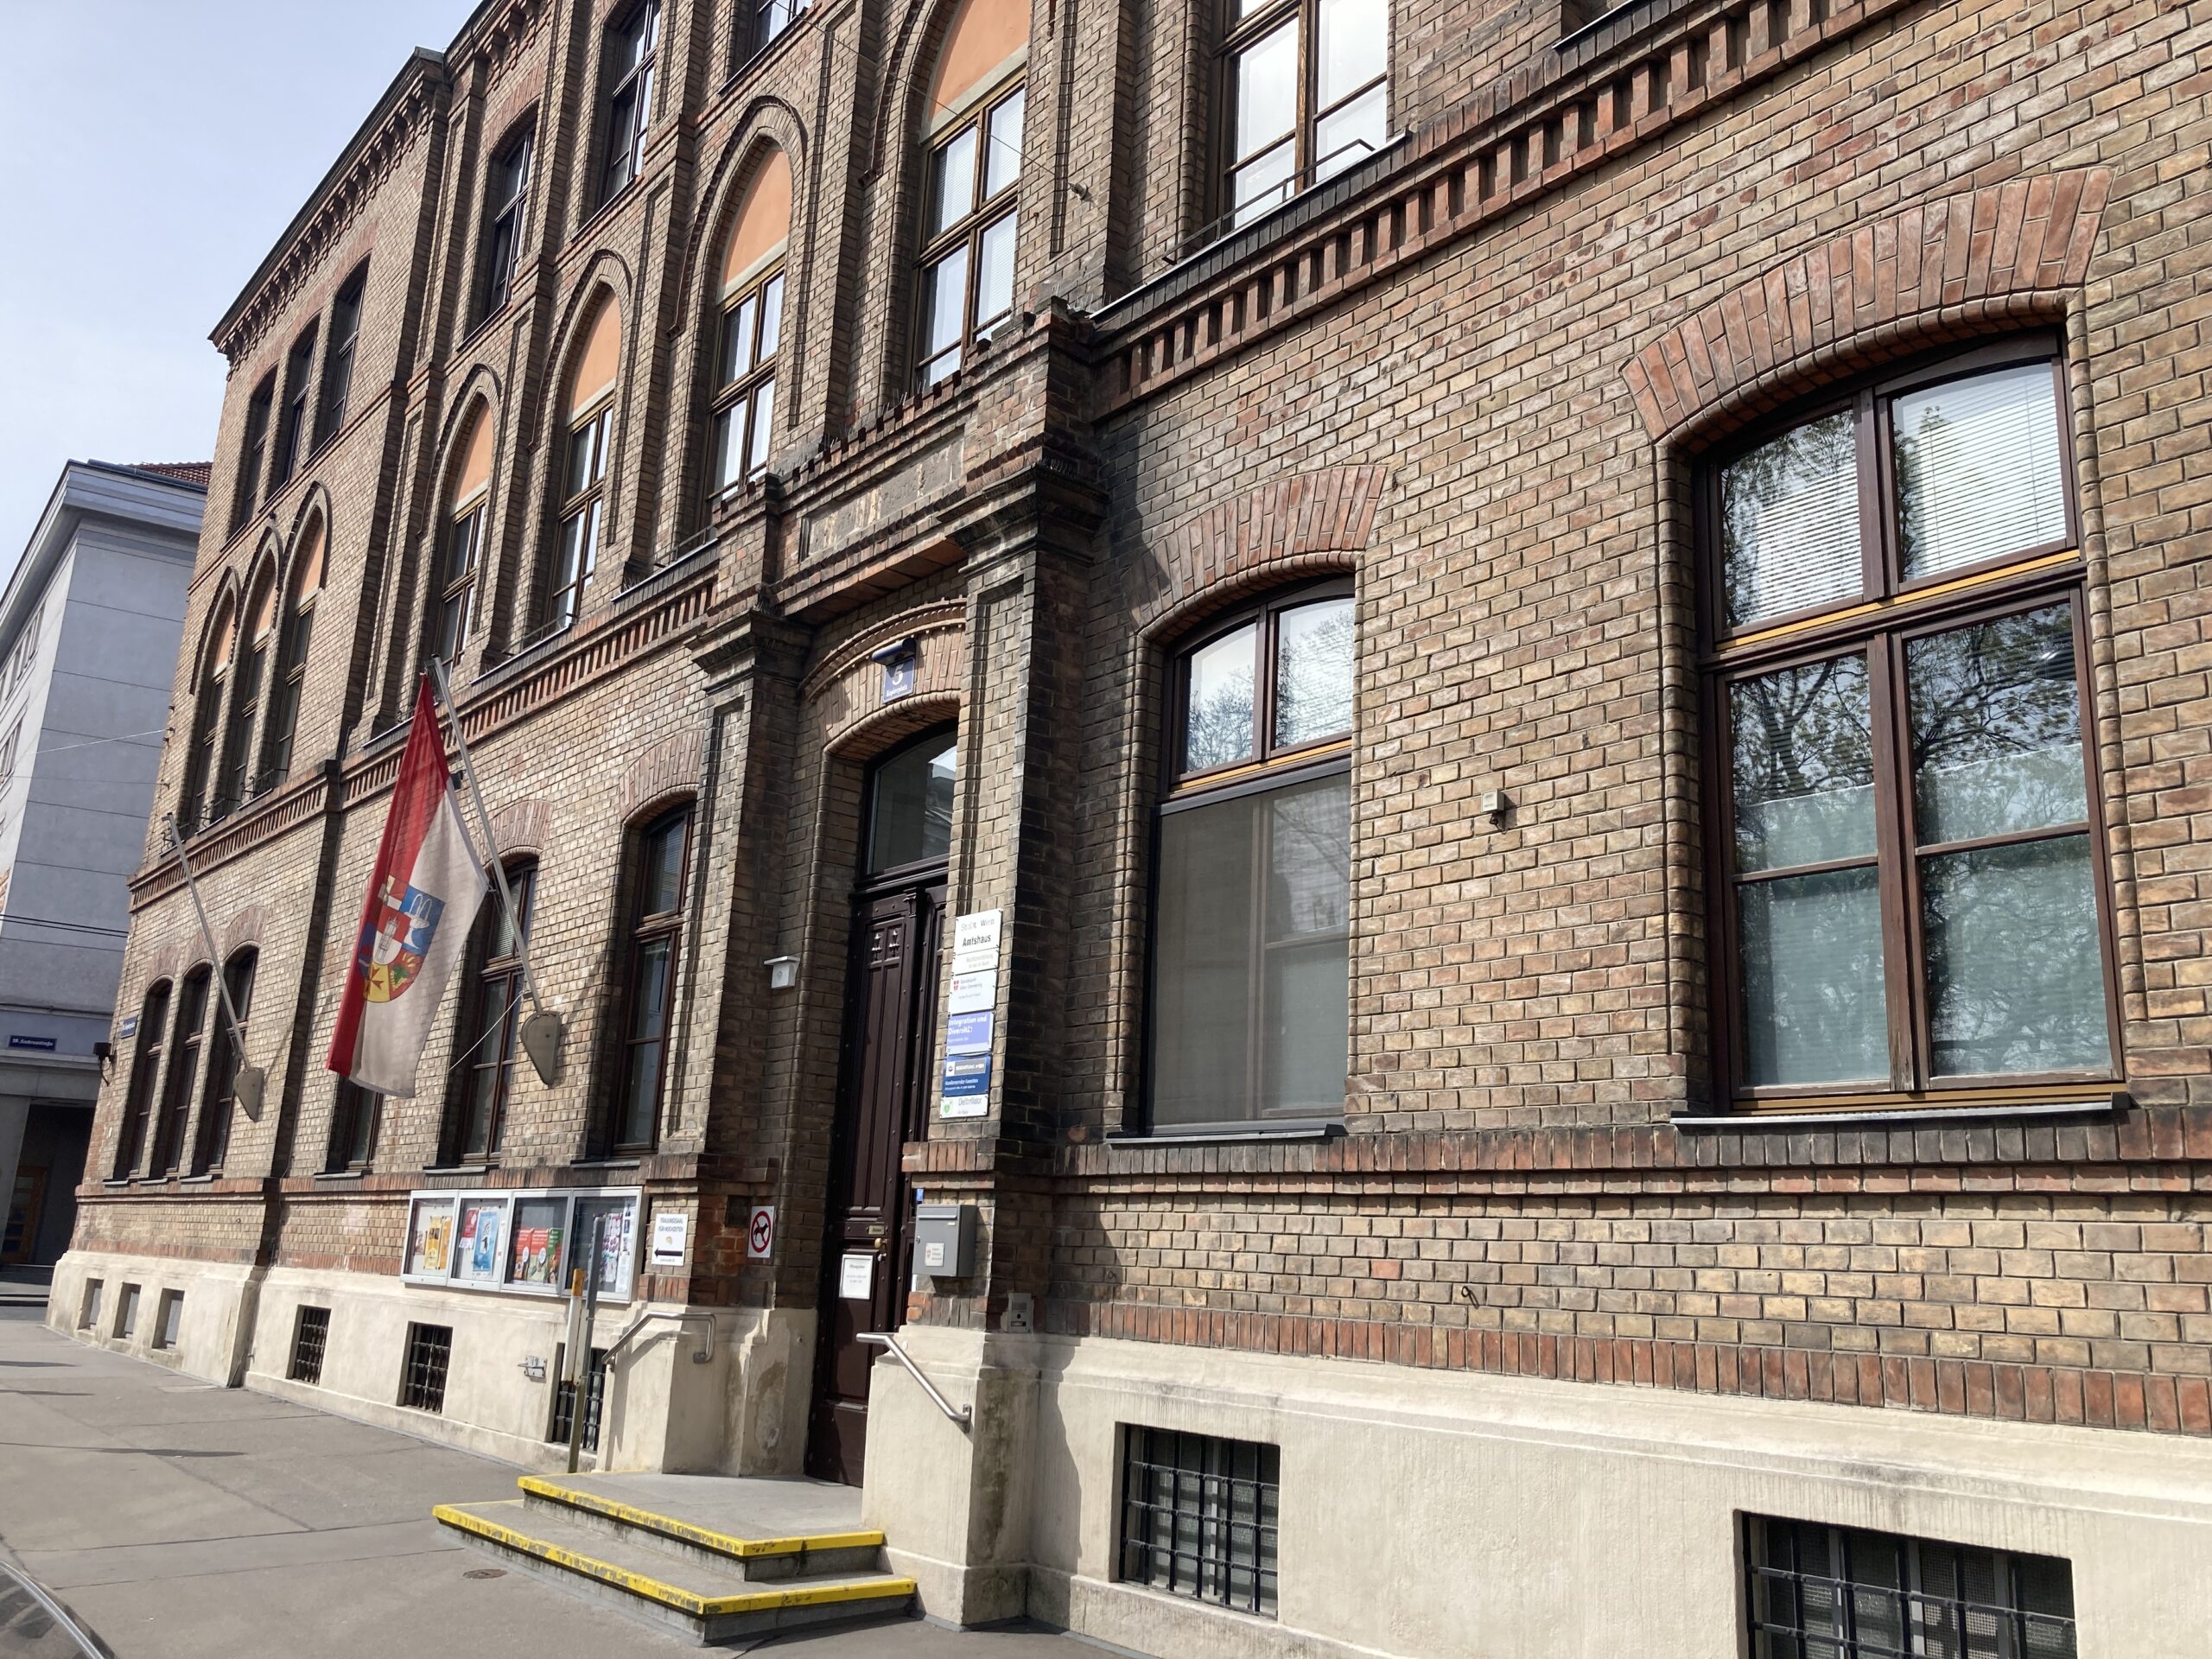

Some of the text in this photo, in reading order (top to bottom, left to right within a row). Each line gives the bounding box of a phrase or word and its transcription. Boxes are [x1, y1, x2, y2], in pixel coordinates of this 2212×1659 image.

[892, 664, 904, 686] 5
[962, 934, 991, 947] Amtshaus
[948, 1017, 976, 1027] Integration
